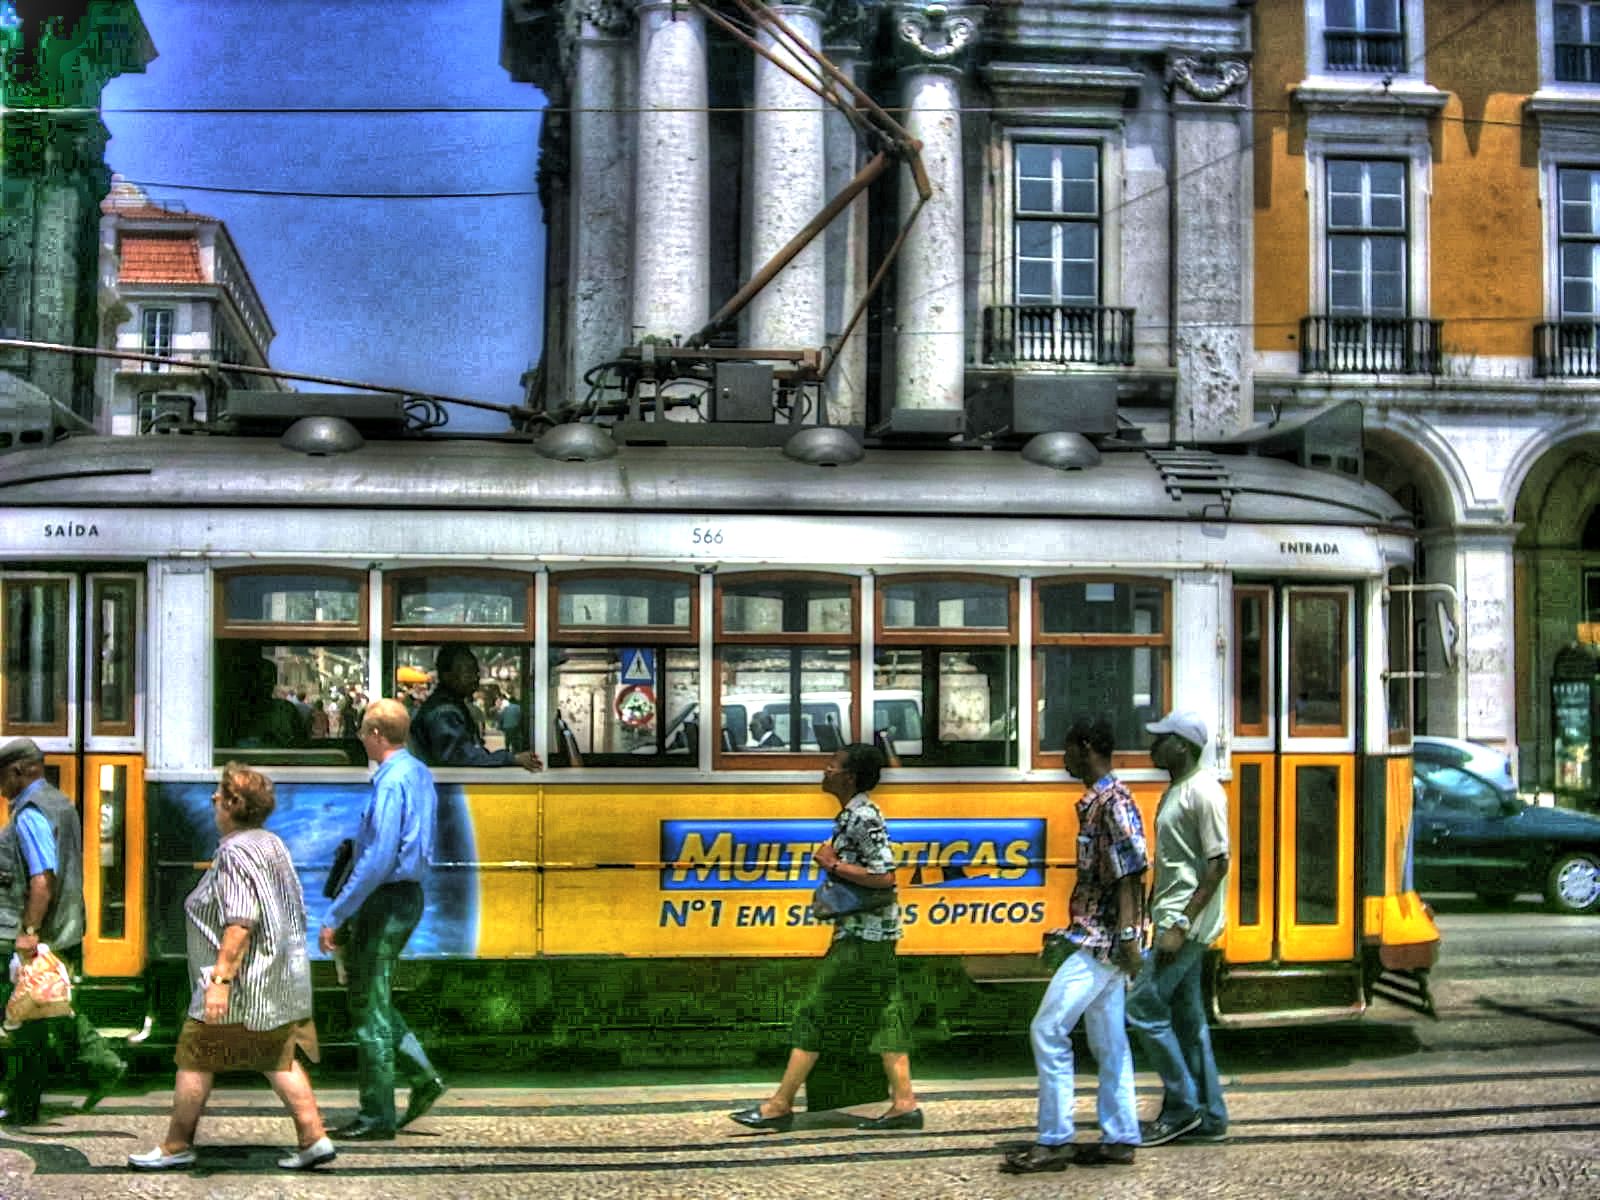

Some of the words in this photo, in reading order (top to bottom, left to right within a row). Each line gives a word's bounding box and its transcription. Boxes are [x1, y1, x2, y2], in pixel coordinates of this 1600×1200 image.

[44, 521, 99, 537] SAÍDA
[692, 527, 724, 544] 566
[1280, 541, 1340, 555] ENTRADA
[672, 832, 1031, 882] MULTITICAS
[736, 906, 776, 927] EM
[928, 896, 1046, 925] ÓPTICOS
